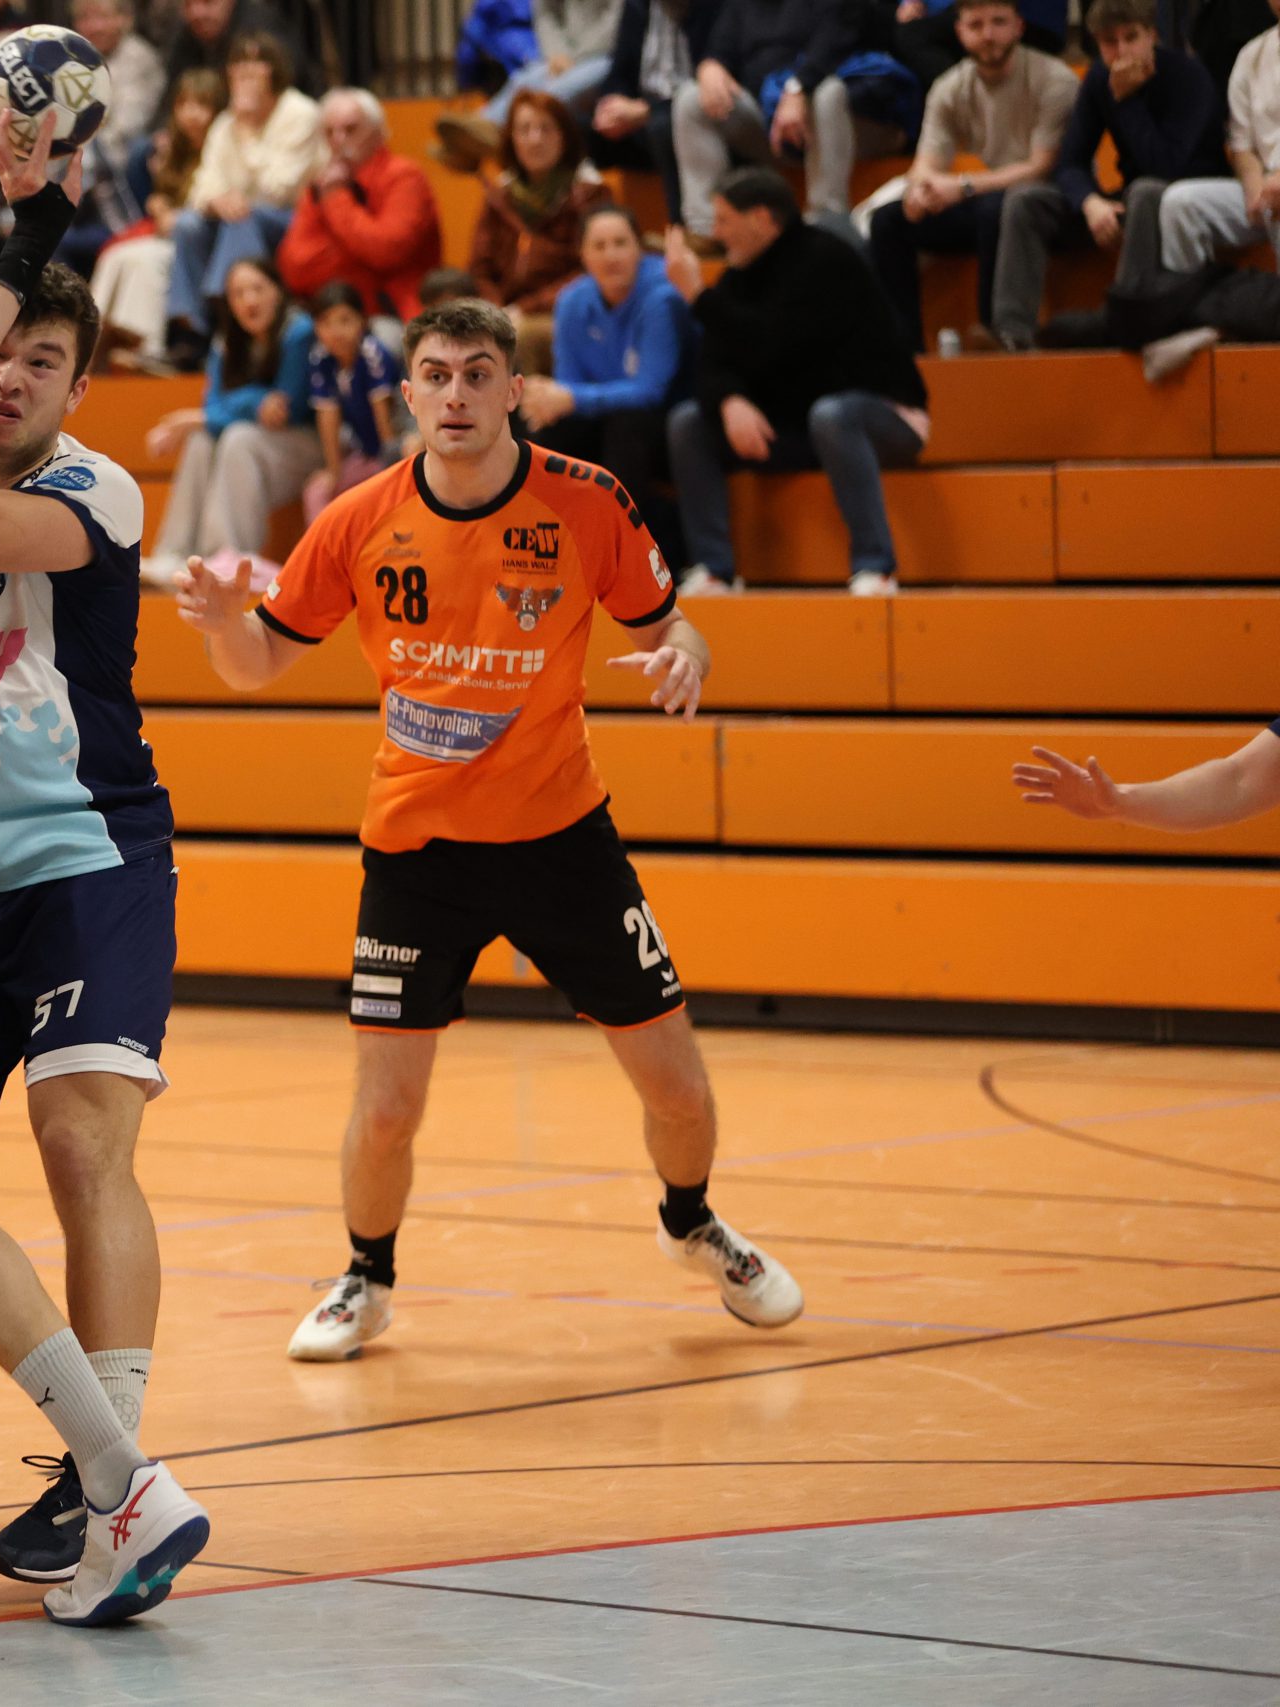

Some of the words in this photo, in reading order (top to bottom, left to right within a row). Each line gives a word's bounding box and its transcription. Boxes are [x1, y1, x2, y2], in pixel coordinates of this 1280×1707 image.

[502, 559, 529, 569] HANS
[531, 561, 558, 570] WALZ
[376, 566, 428, 625] 28
[388, 637, 522, 674] SCHMITT
[623, 899, 669, 971] 28
[30, 979, 84, 1038] 57
